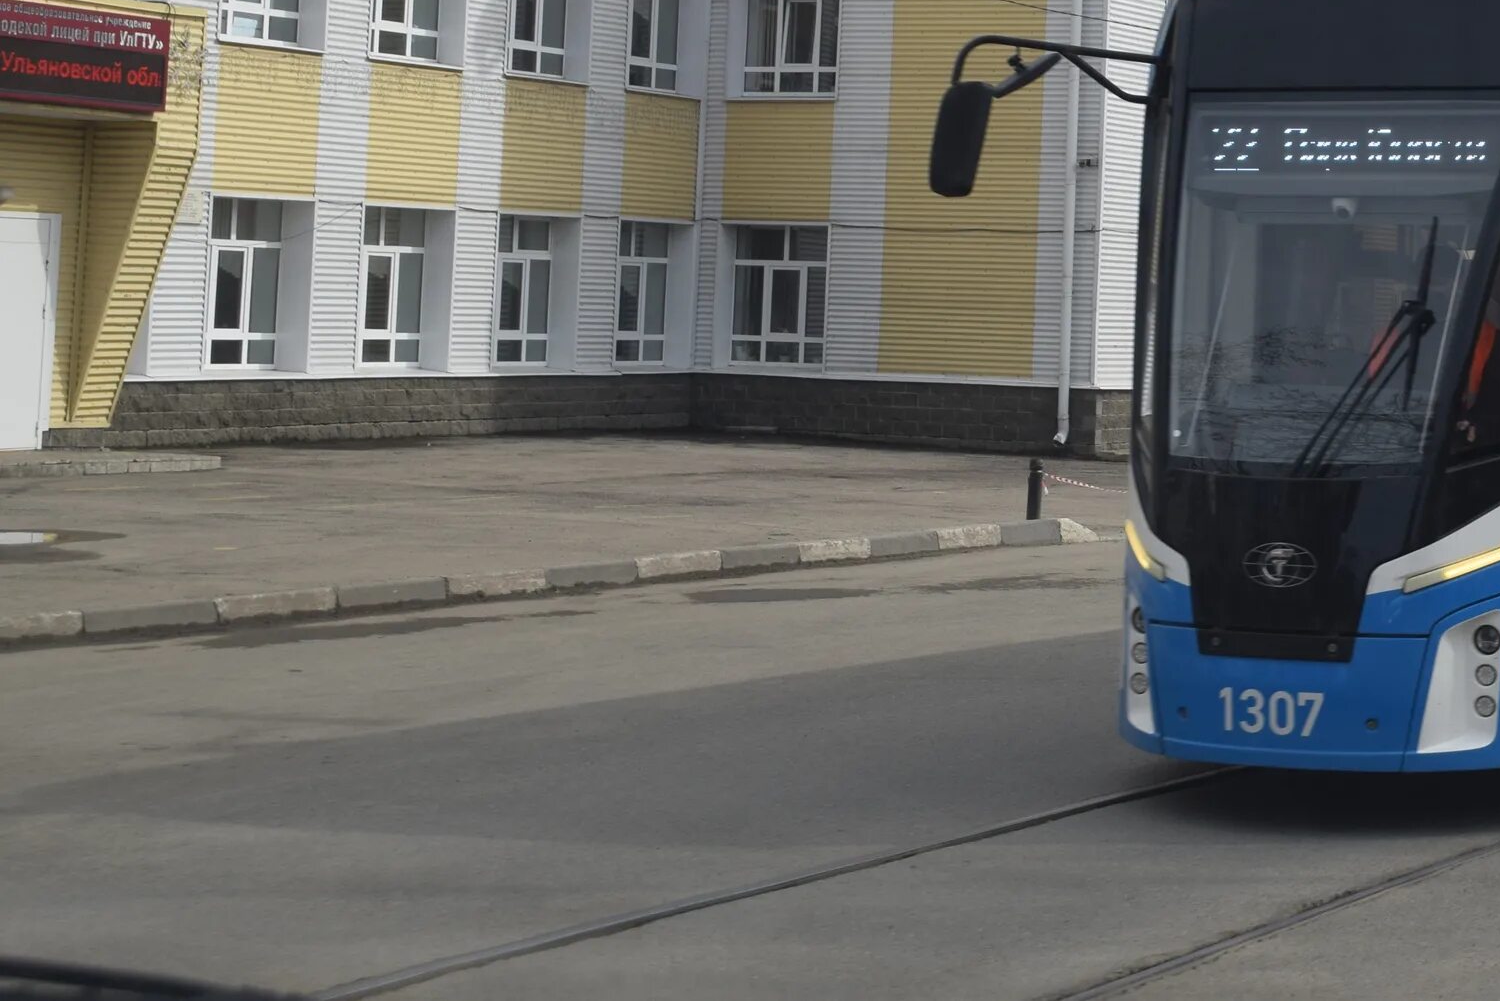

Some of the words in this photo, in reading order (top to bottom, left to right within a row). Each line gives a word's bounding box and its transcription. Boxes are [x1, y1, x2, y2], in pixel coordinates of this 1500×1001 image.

[51, 24, 90, 42] лицей
[93, 30, 116, 47] при
[119, 30, 164, 50] УлГТУ»
[105, 16, 151, 29] учреждение
[1, 50, 121, 83] Ульяновской
[1218, 687, 1325, 737] 1307
